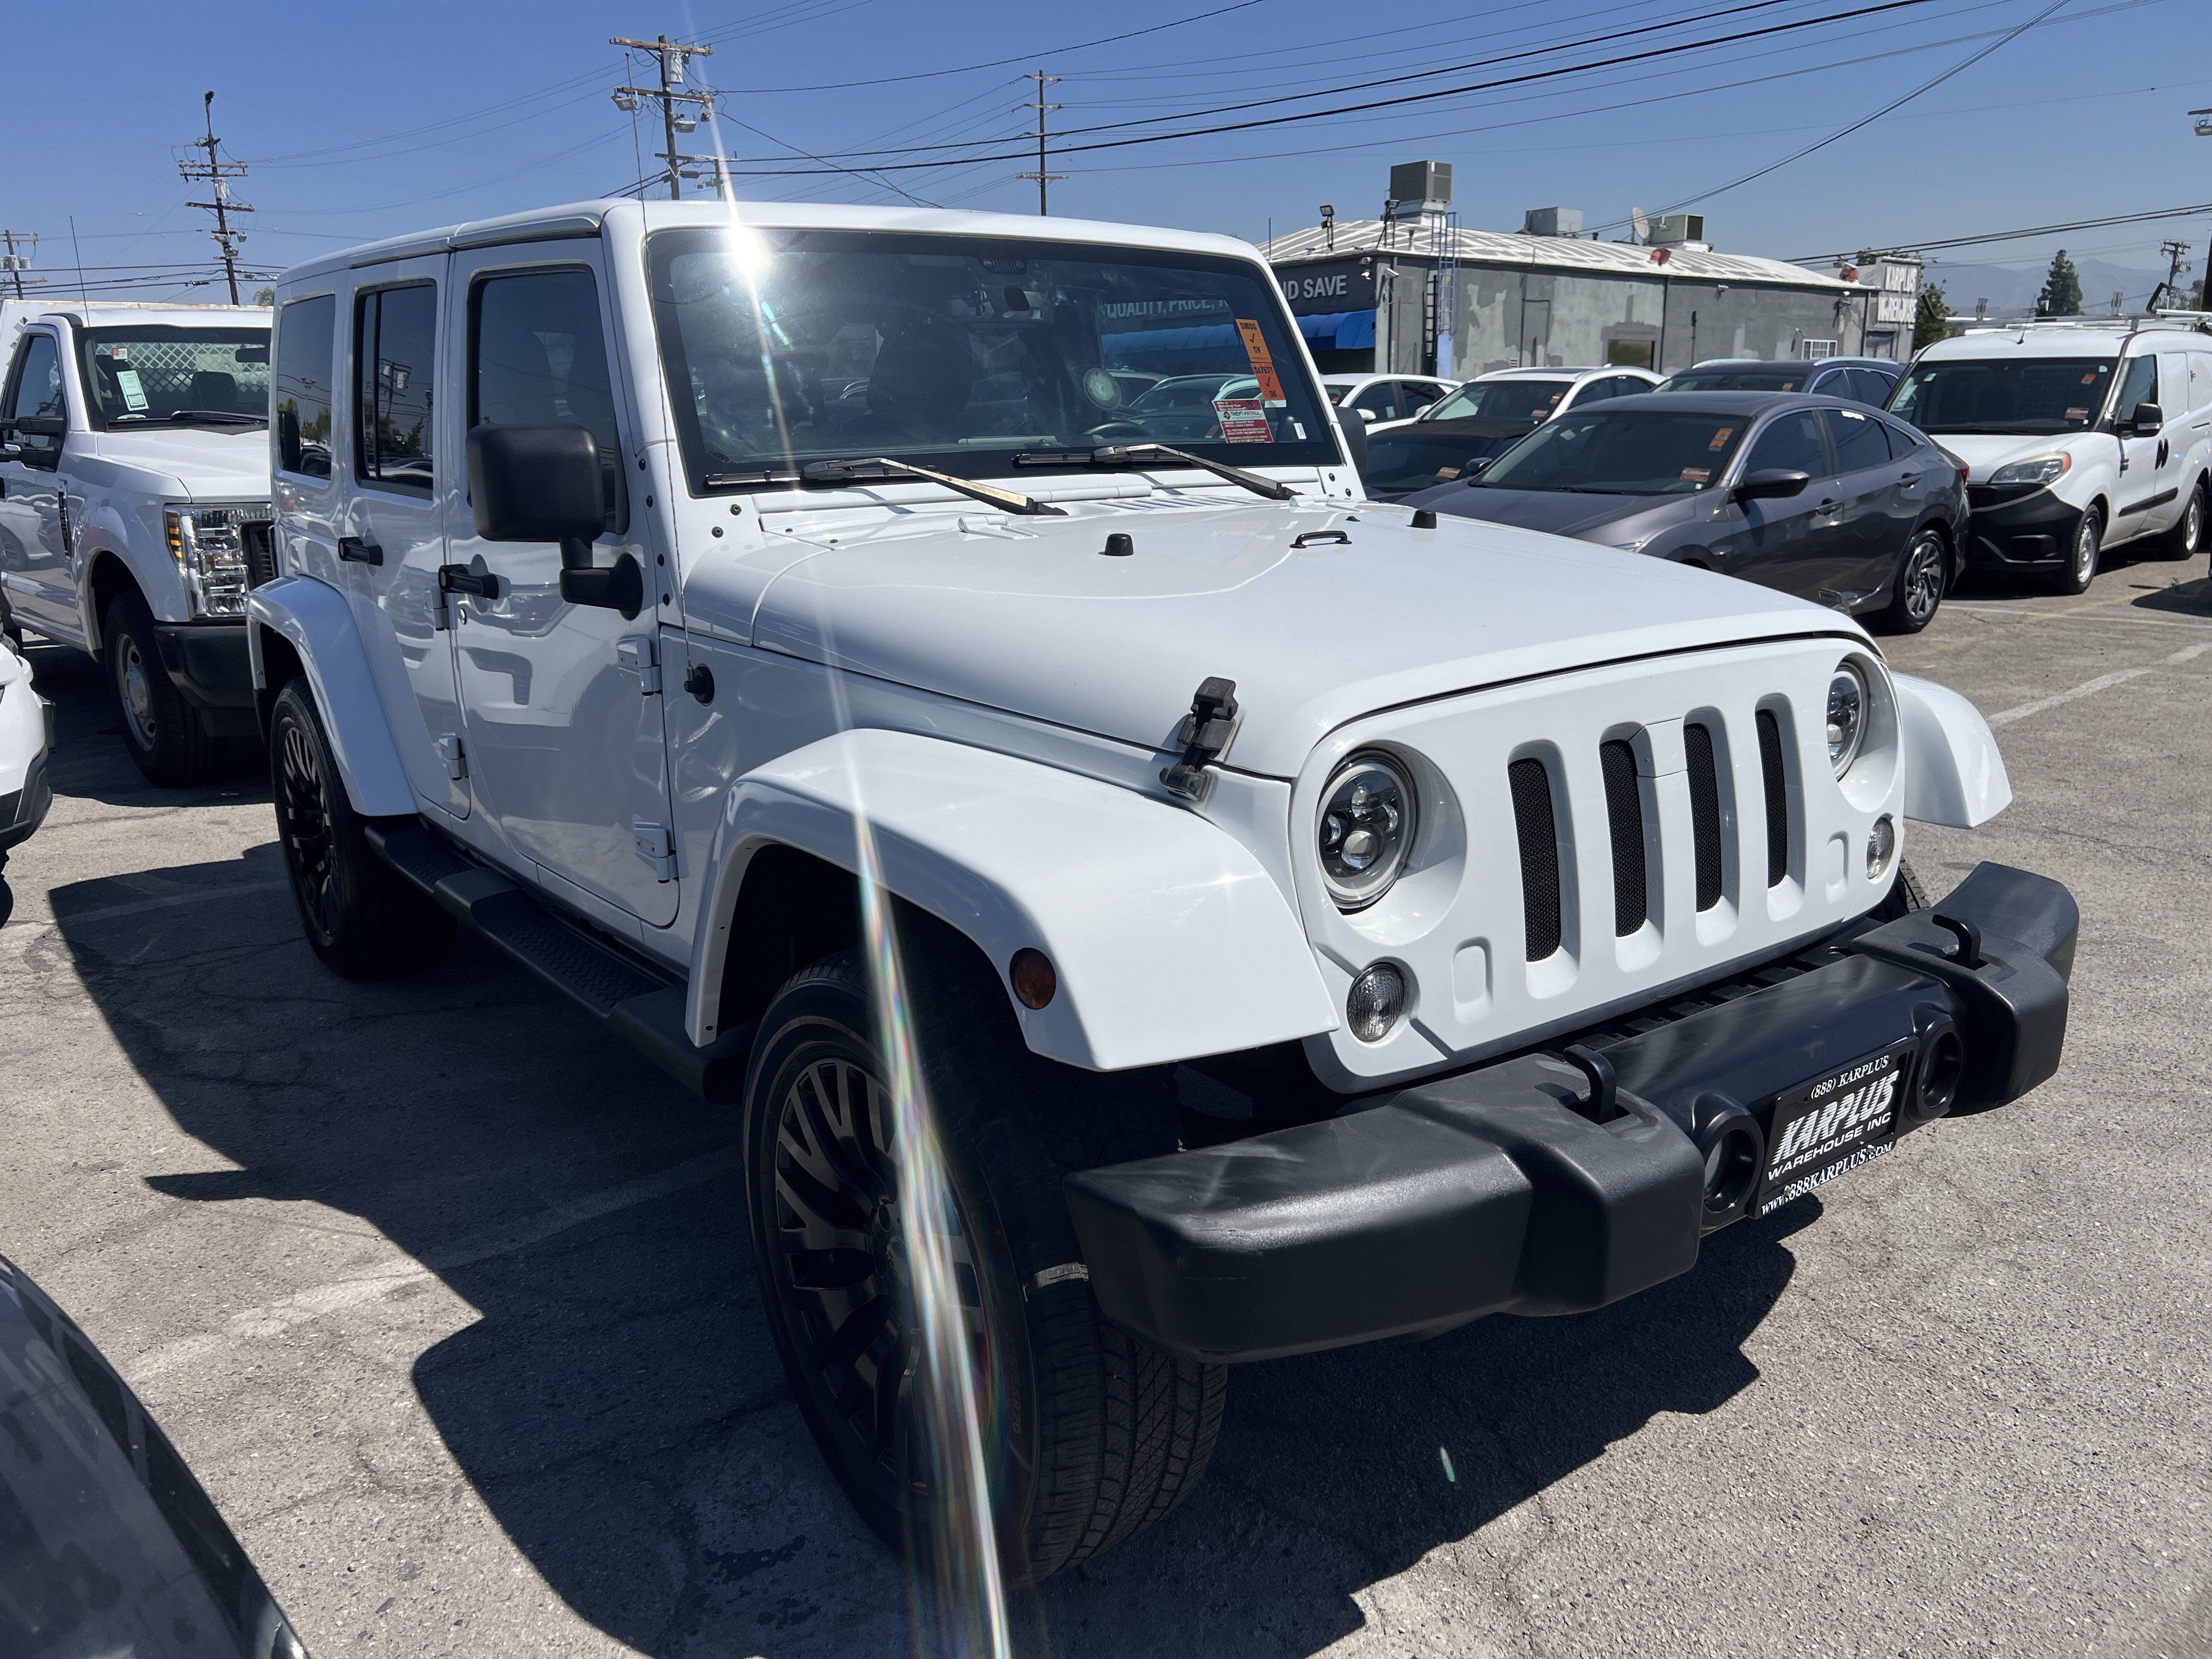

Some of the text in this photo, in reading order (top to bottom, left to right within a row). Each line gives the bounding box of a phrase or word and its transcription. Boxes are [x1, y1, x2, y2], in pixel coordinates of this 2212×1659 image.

[1303, 275, 1347, 298] SAVE
[1811, 1055, 1889, 1099] (888) KARPLUS
[1768, 1111, 1892, 1181] WAREHOUSE INC
[1770, 1070, 1899, 1165] KARPLUS
